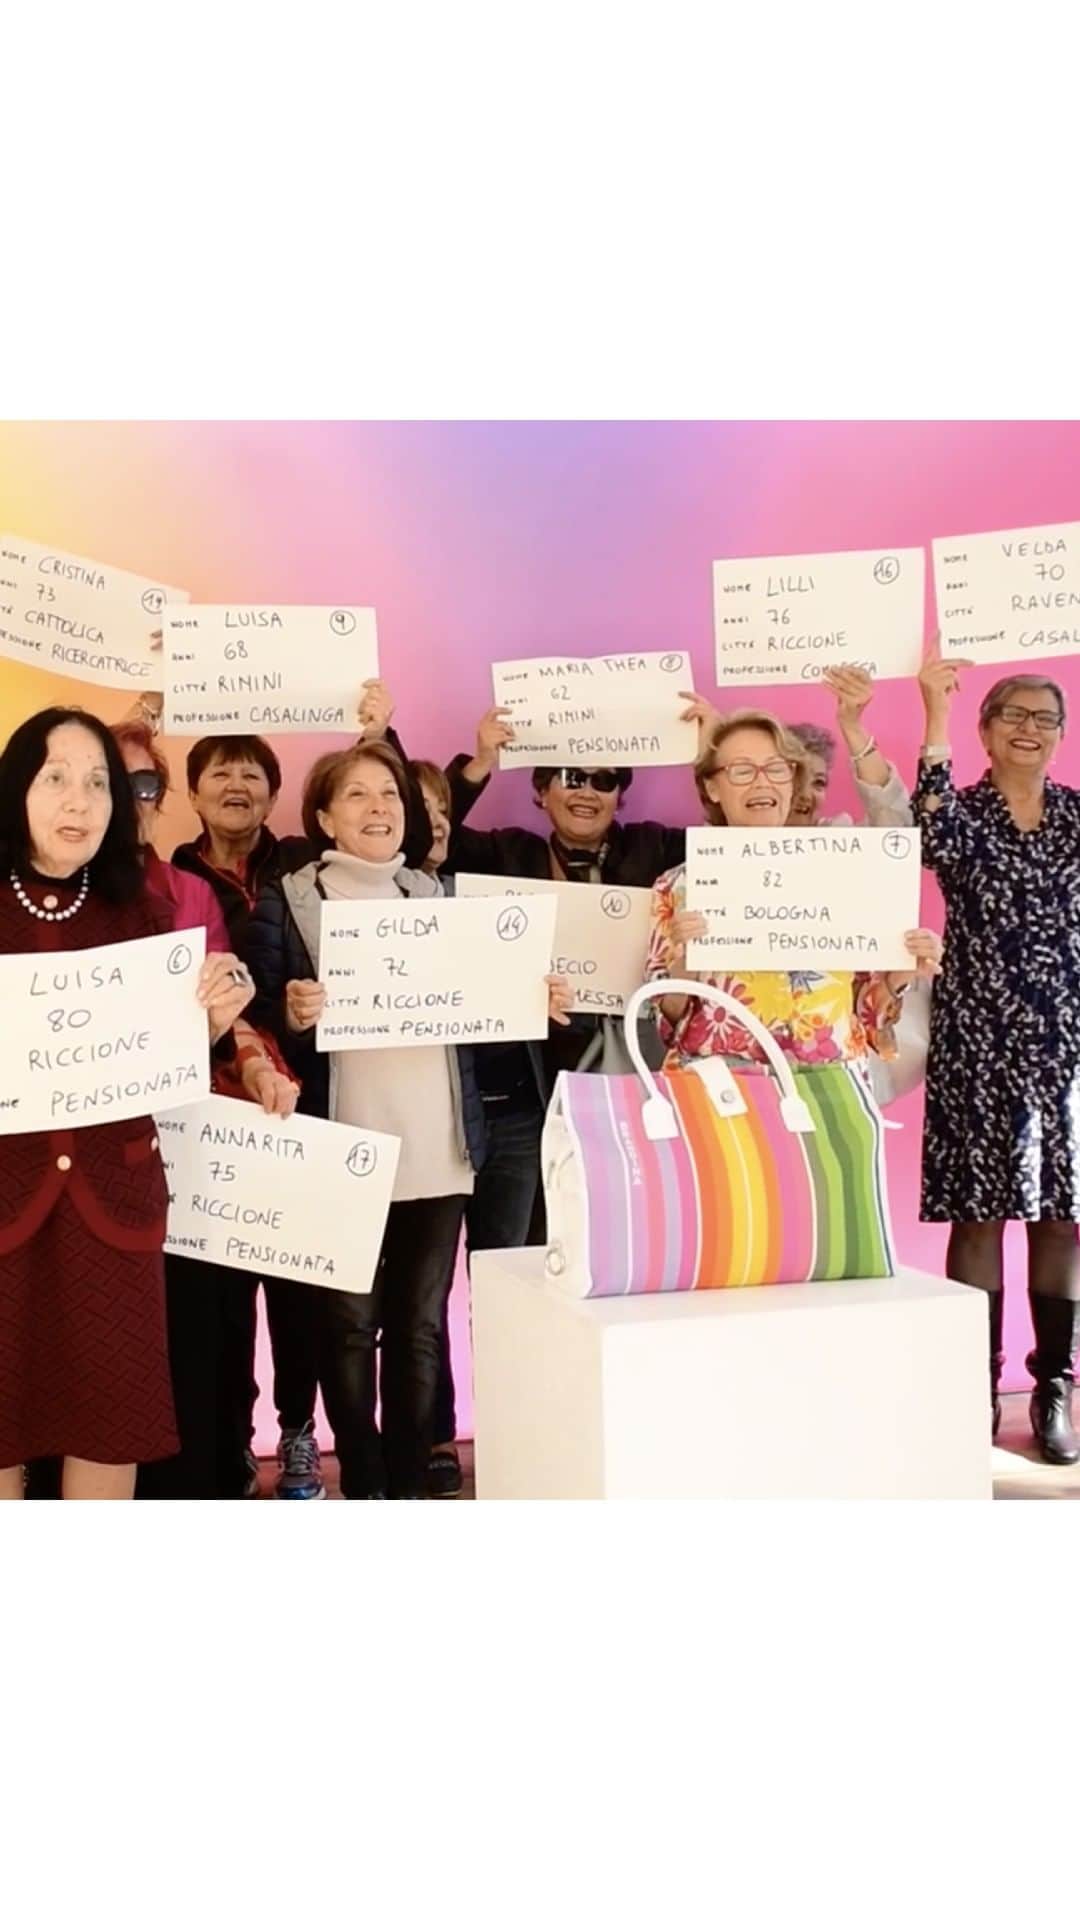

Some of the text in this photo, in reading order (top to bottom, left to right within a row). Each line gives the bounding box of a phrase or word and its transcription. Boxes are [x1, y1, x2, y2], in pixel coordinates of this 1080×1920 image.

[38, 556, 106, 591] CRISTINA
[1034, 563, 1065, 581] 70
[37, 583, 56, 602] 73
[723, 575, 815, 597] NOME LILLI
[24, 610, 104, 644] CATTOLICA
[170, 610, 284, 629] NOME LUISA
[766, 608, 791, 626] 76
[224, 640, 248, 660] 68
[767, 631, 848, 651] RICCIONE
[51, 642, 154, 676] RICERCATRICE
[539, 662, 594, 678] MARIA
[603, 656, 647, 672] THEA
[218, 671, 283, 694] RIMINI
[250, 706, 344, 723] CASALINGA
[548, 709, 595, 728] RIMINI
[568, 735, 661, 755] PENSIONATA
[741, 837, 863, 858] ALBERTINA
[762, 870, 783, 888] 82
[744, 904, 831, 921] BOLOGNA
[330, 915, 440, 938] NOME GILDA
[768, 931, 879, 952] PENSIONATA
[30, 966, 125, 996] LUISA
[328, 968, 355, 977] ANNI
[371, 990, 464, 1010] RICCIONE
[48, 1008, 92, 1033] 80
[400, 1018, 505, 1037] PENSIONATA
[28, 1031, 151, 1072] RICCIONE
[51, 1064, 198, 1116] PENSIONATA
[157, 1121, 305, 1160] NOME ANNARITA
[208, 1161, 237, 1182] 75
[191, 1193, 284, 1230] RICCIONE
[226, 1236, 336, 1276] PENSIONATA
